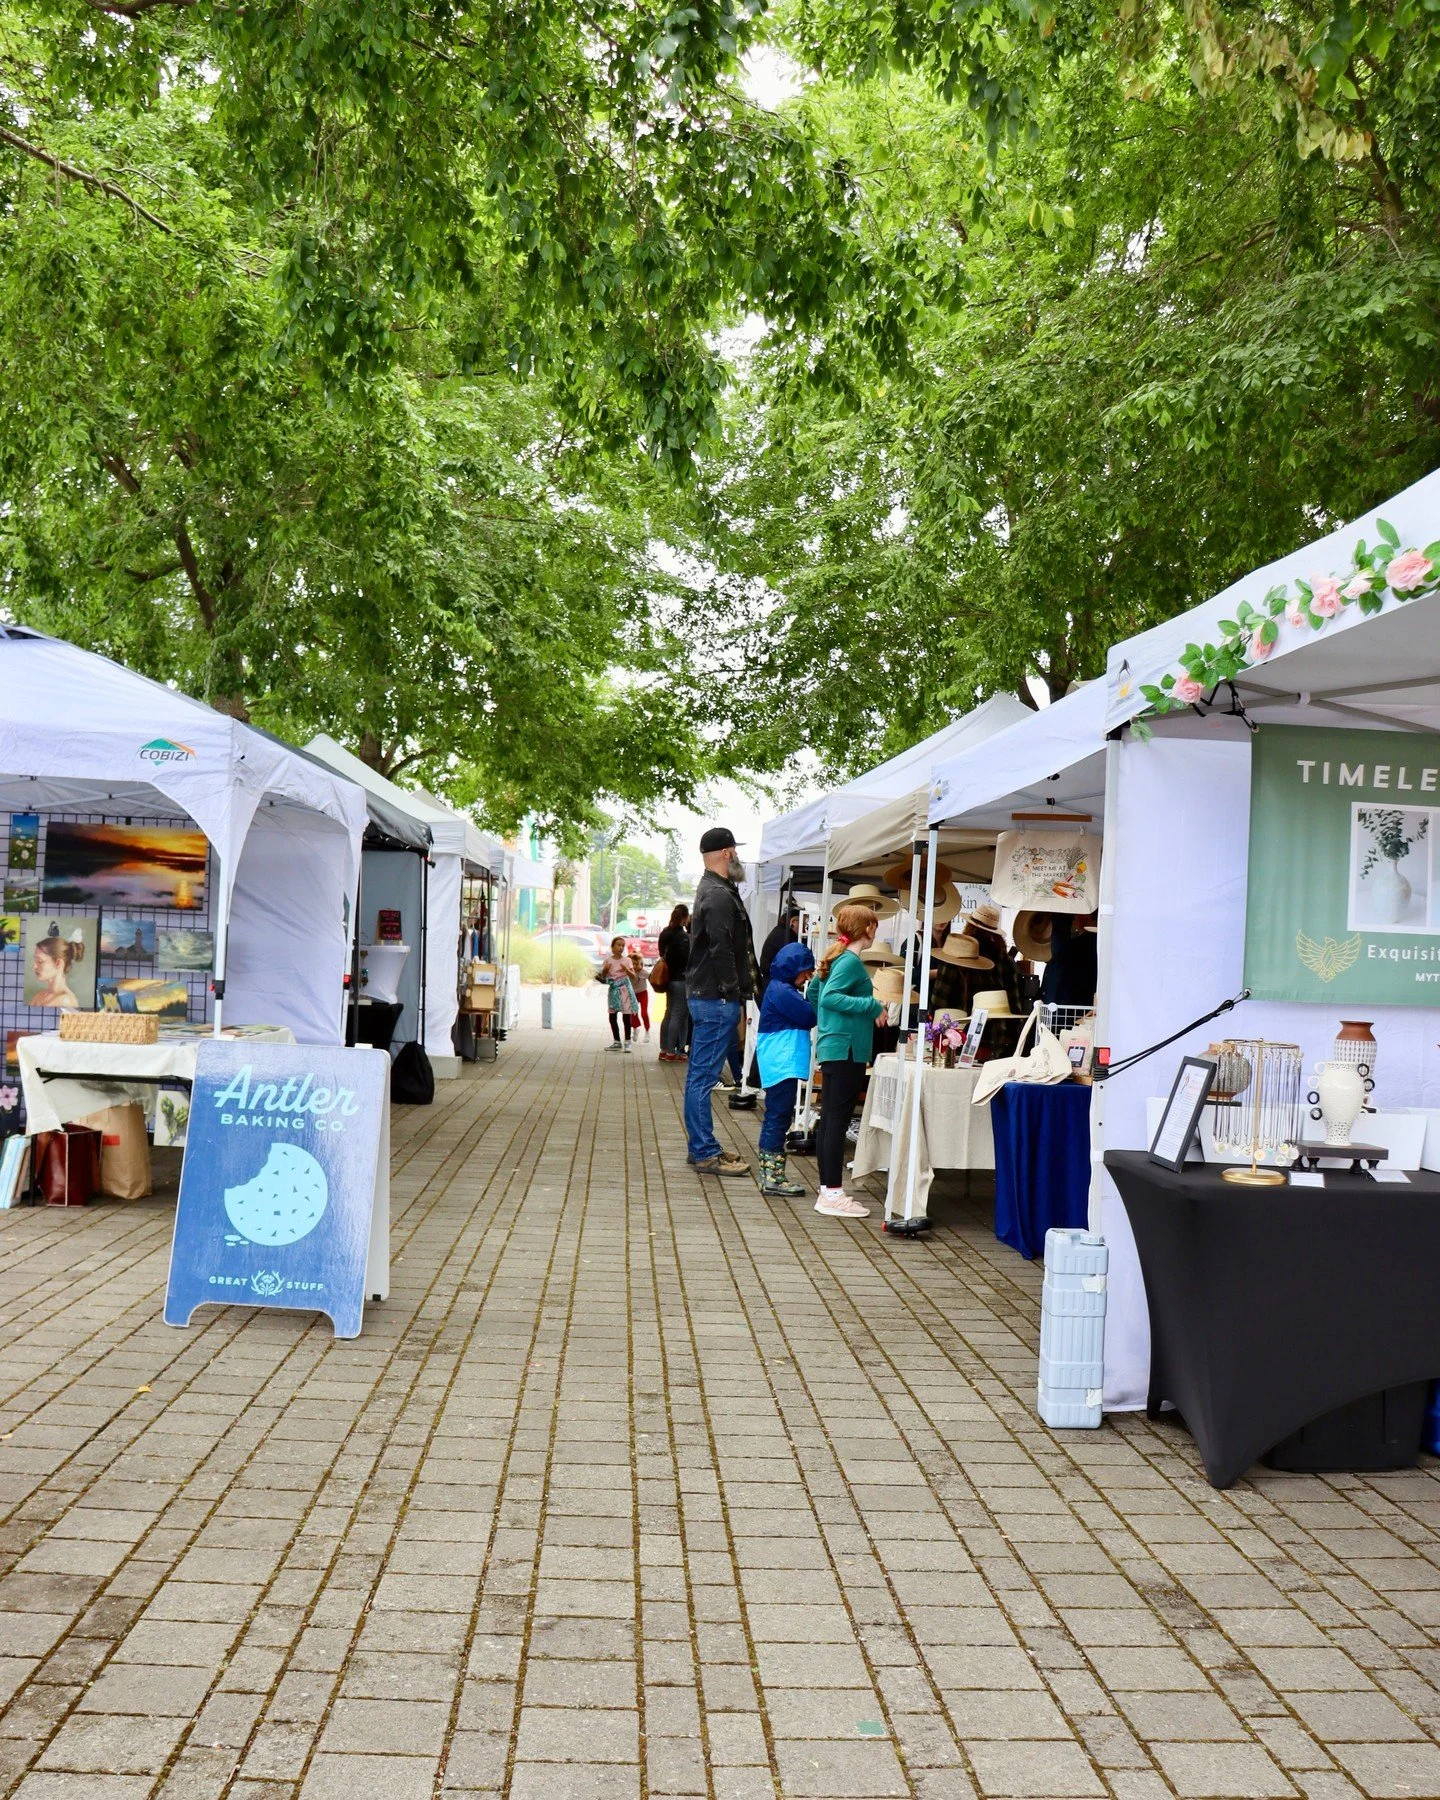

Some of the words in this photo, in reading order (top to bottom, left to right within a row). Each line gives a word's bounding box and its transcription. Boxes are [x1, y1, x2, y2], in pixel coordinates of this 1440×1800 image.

[140, 749, 189, 761] COBIZI
[1296, 759, 1439, 792] TIMELE
[1415, 972, 1440, 982] MYT
[213, 1063, 360, 1117] Antler
[220, 1113, 305, 1130] BAKING
[314, 1119, 347, 1133] CO.
[208, 1275, 248, 1286] GREAT
[286, 1281, 324, 1291] STUFF
